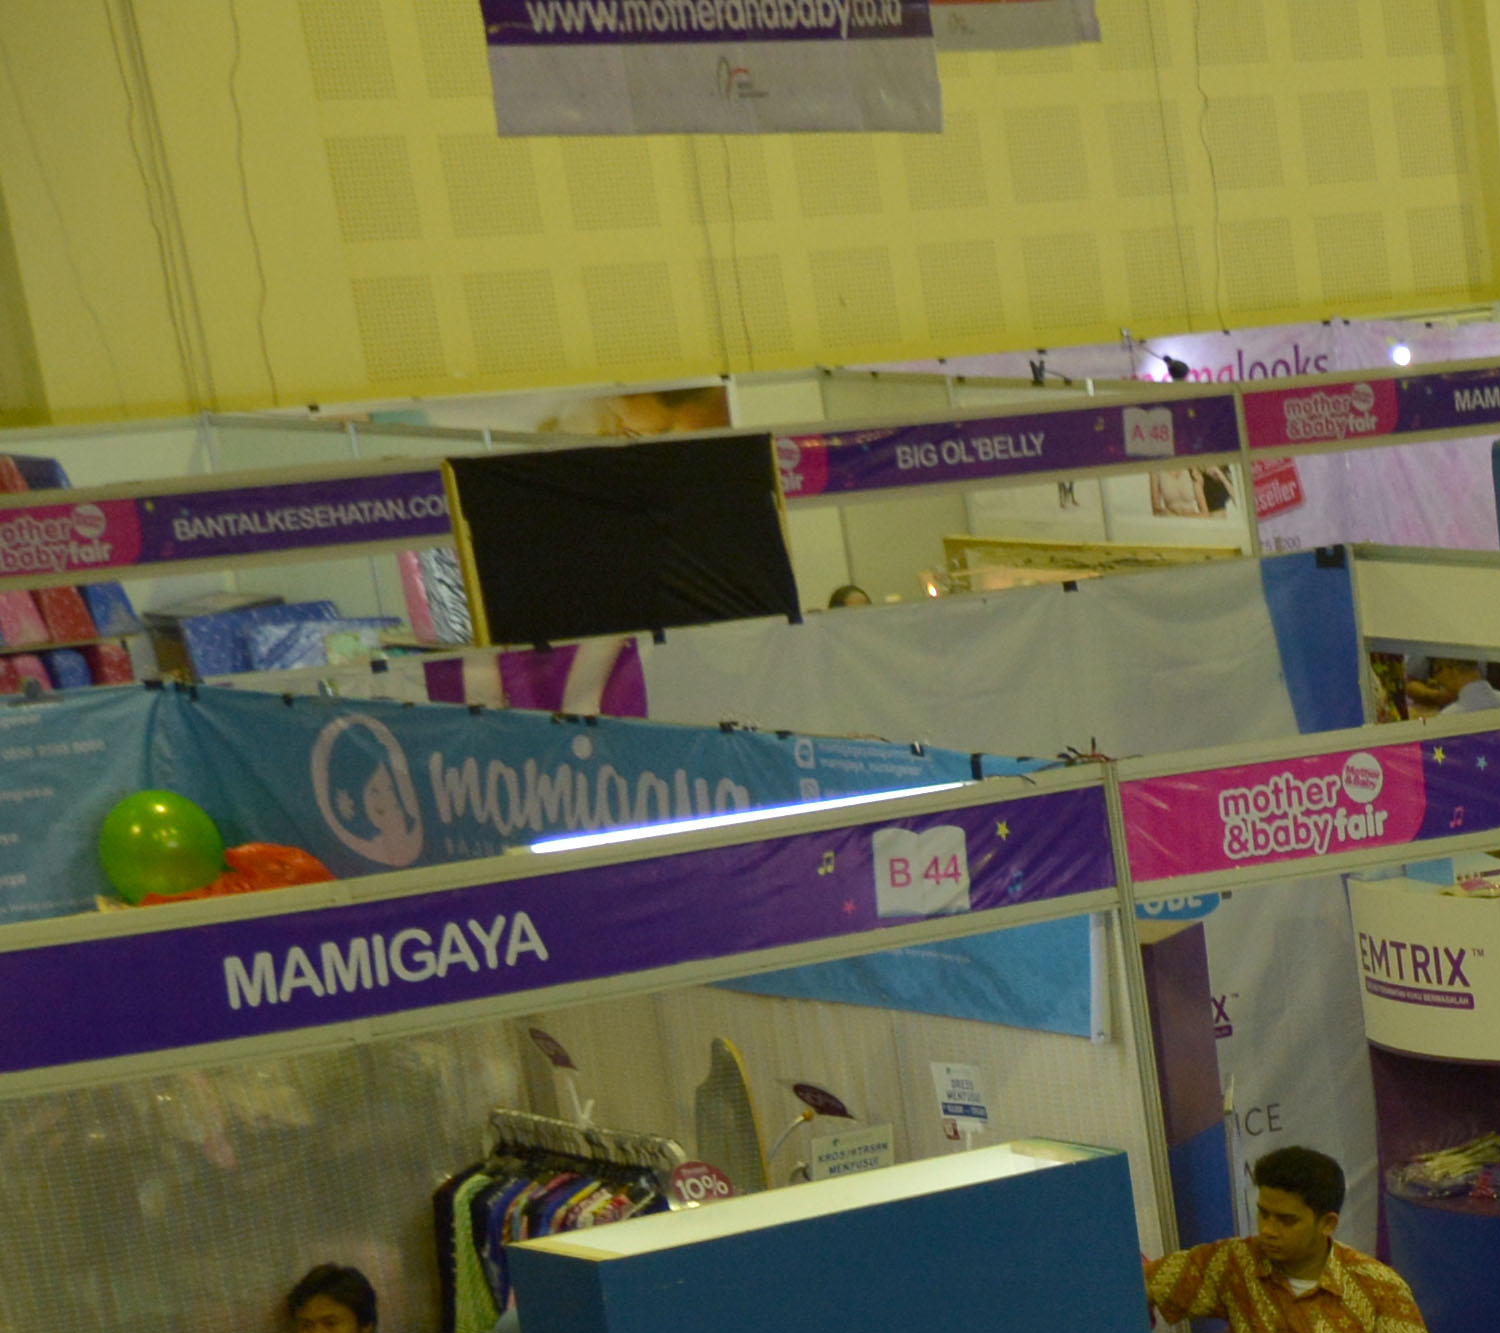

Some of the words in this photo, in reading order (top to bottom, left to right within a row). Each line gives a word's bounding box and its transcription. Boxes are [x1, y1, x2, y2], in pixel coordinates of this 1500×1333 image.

[896, 442, 938, 471] BIG
[943, 430, 1045, 467] OL'BELLY
[1149, 424, 1171, 441] 48
[1219, 773, 1338, 819] mother
[1223, 812, 1334, 860] &baby
[1335, 800, 1388, 844] fair
[889, 856, 911, 888] B
[923, 853, 962, 885] 44
[222, 910, 549, 1010] MAMIGAYA
[1359, 932, 1471, 988] EMTRIX
[676, 1173, 730, 1202] 10%
